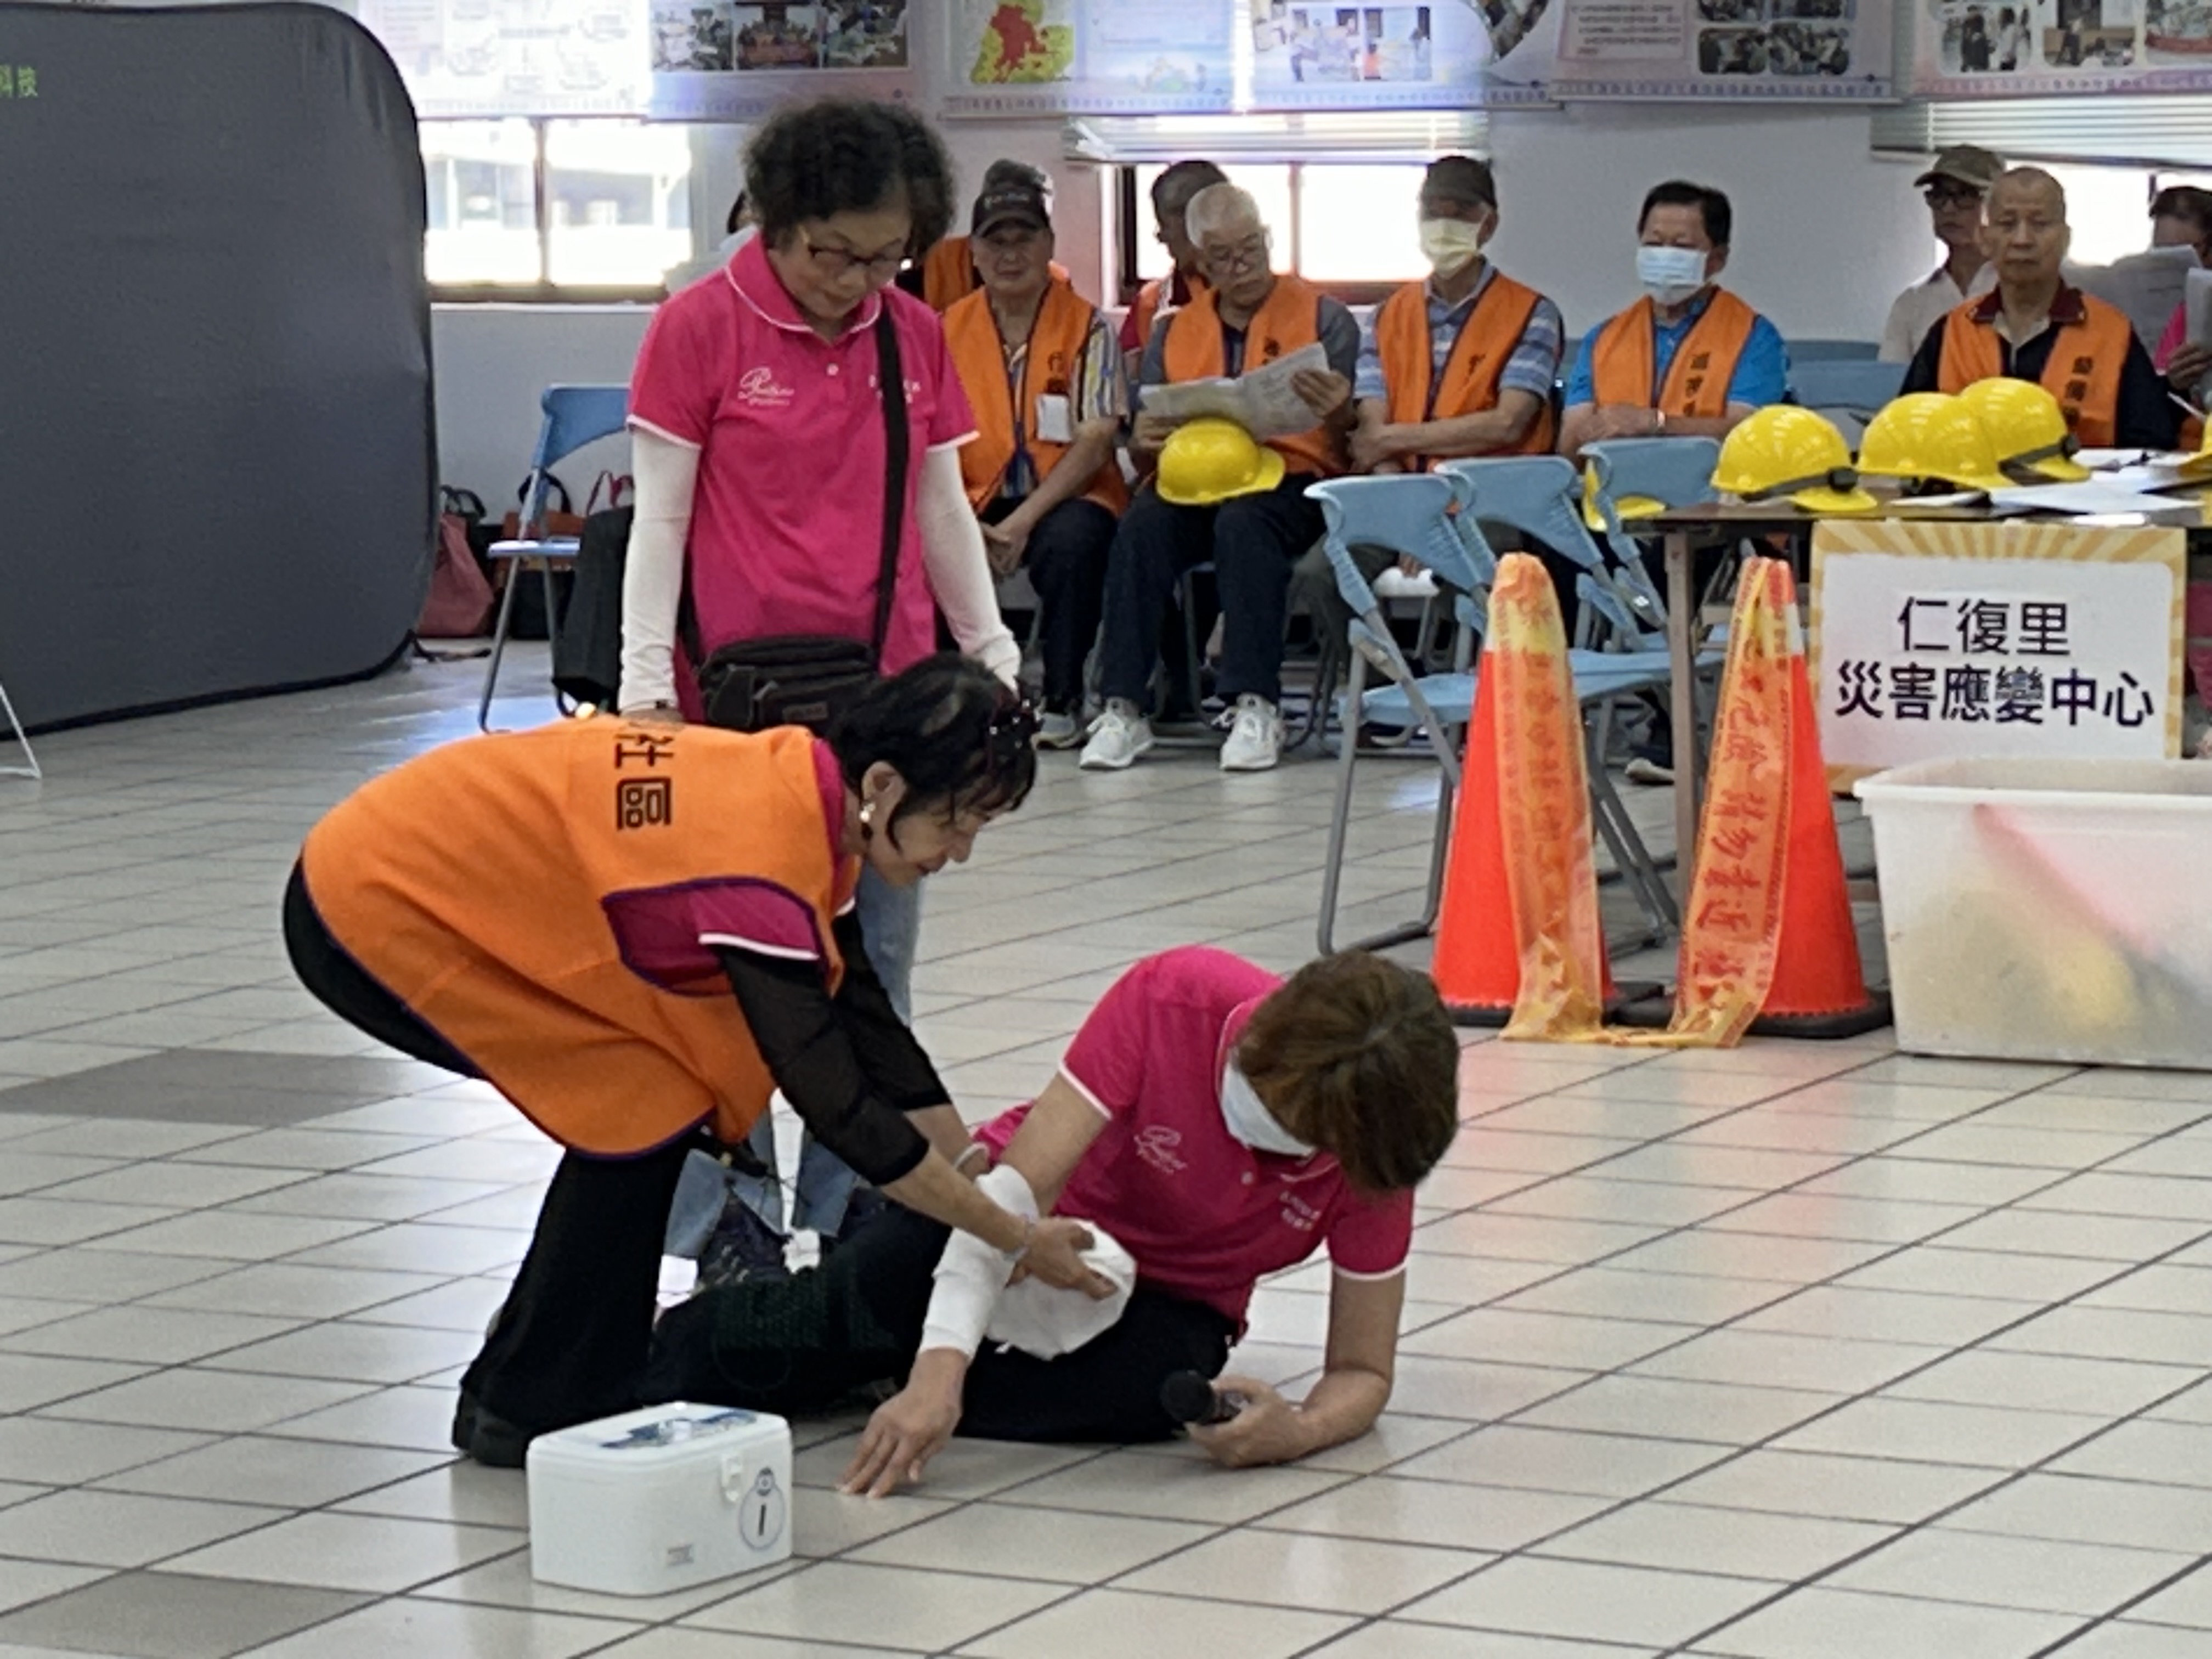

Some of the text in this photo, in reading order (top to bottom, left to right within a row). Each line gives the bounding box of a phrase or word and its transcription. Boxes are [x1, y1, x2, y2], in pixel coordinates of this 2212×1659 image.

[1897, 596, 2071, 657] 仁復里
[1835, 659, 2155, 727] 災害應變中心
[613, 732, 675, 831] 社區
